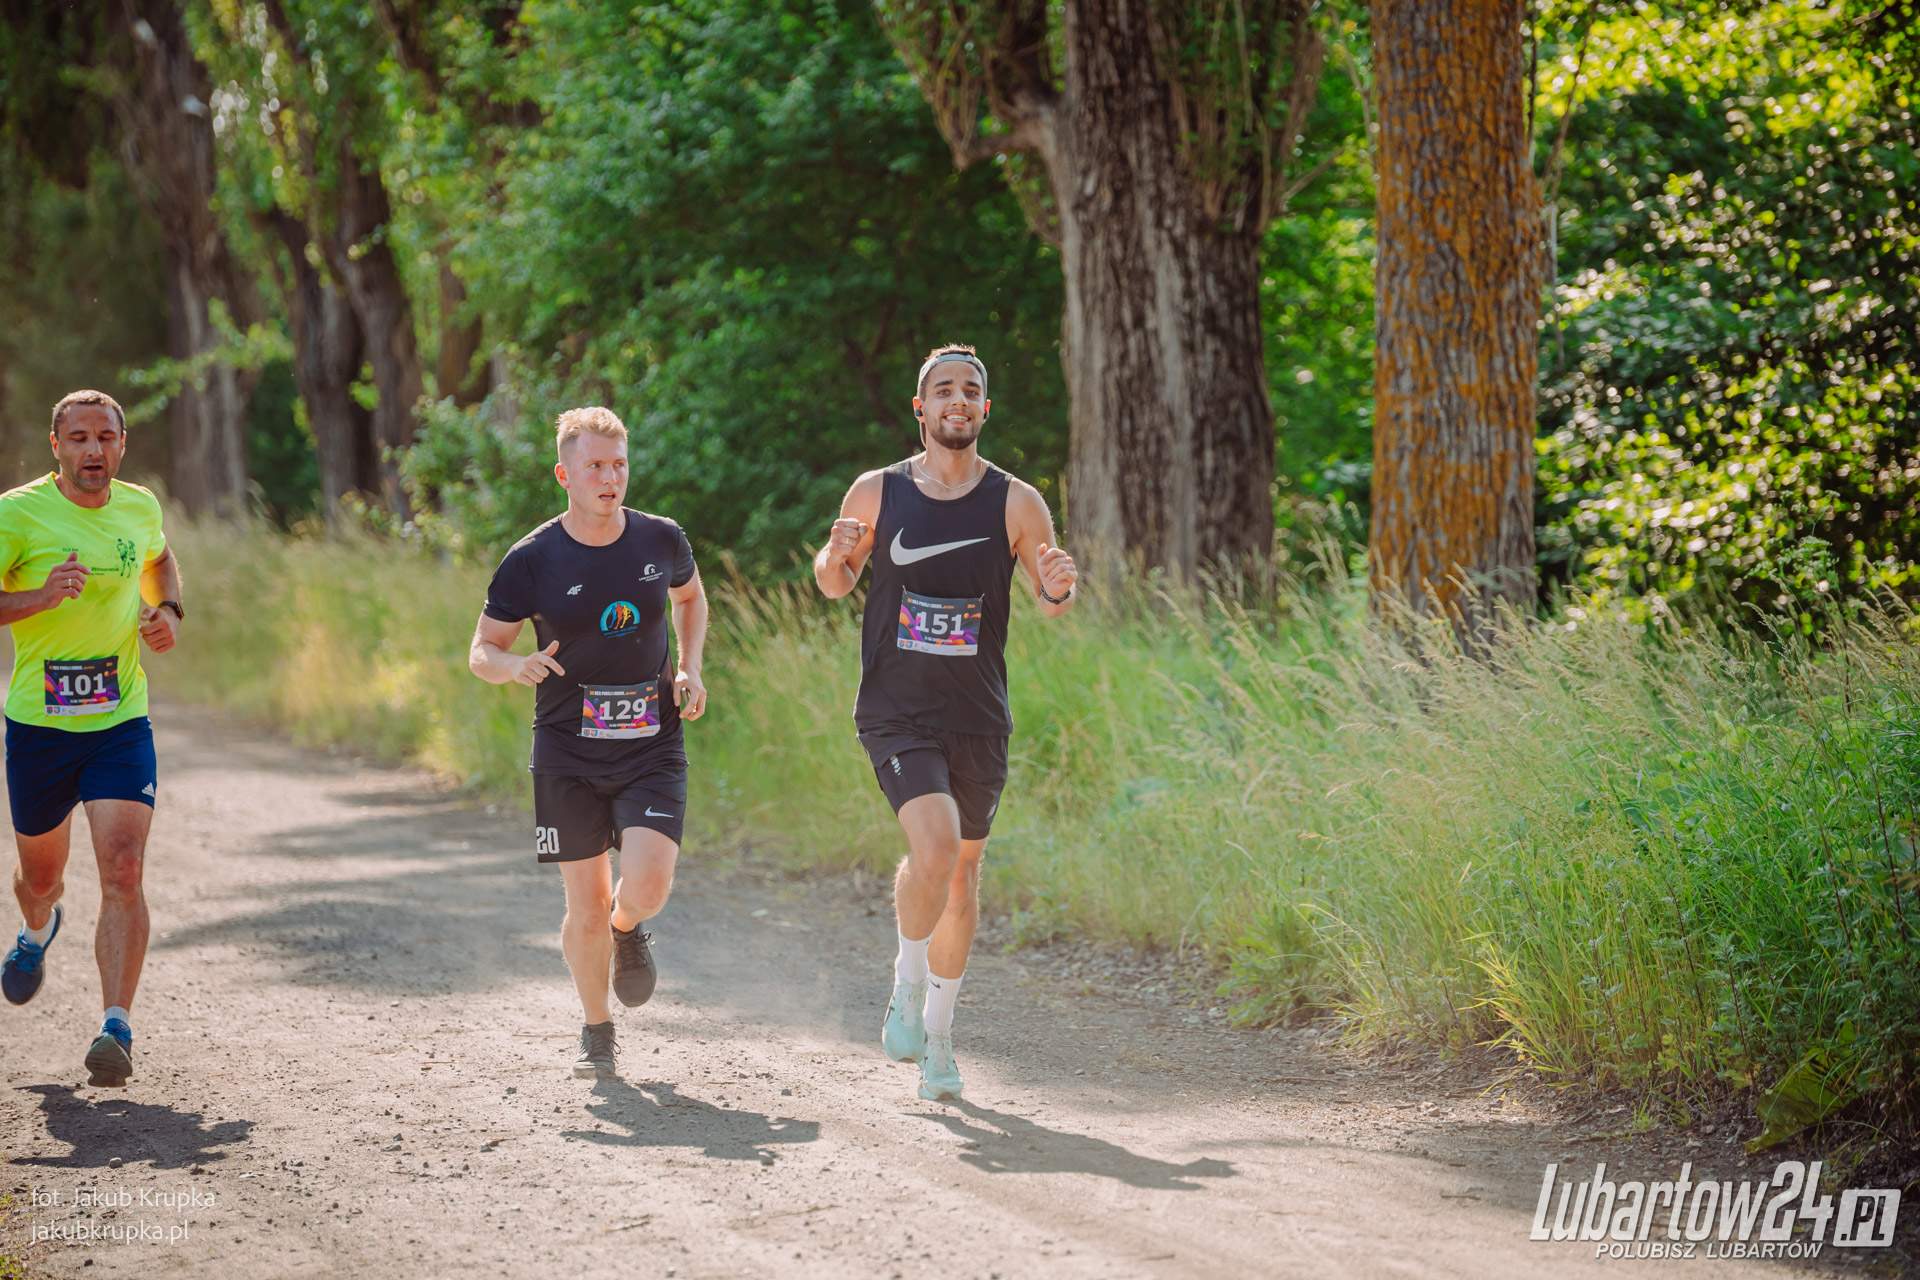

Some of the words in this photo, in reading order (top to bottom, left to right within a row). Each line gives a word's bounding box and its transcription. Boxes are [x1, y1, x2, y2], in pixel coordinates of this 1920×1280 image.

[915, 611, 964, 635] 151
[58, 673, 107, 696] 101
[599, 698, 647, 721] 129
[536, 826, 560, 854] 20
